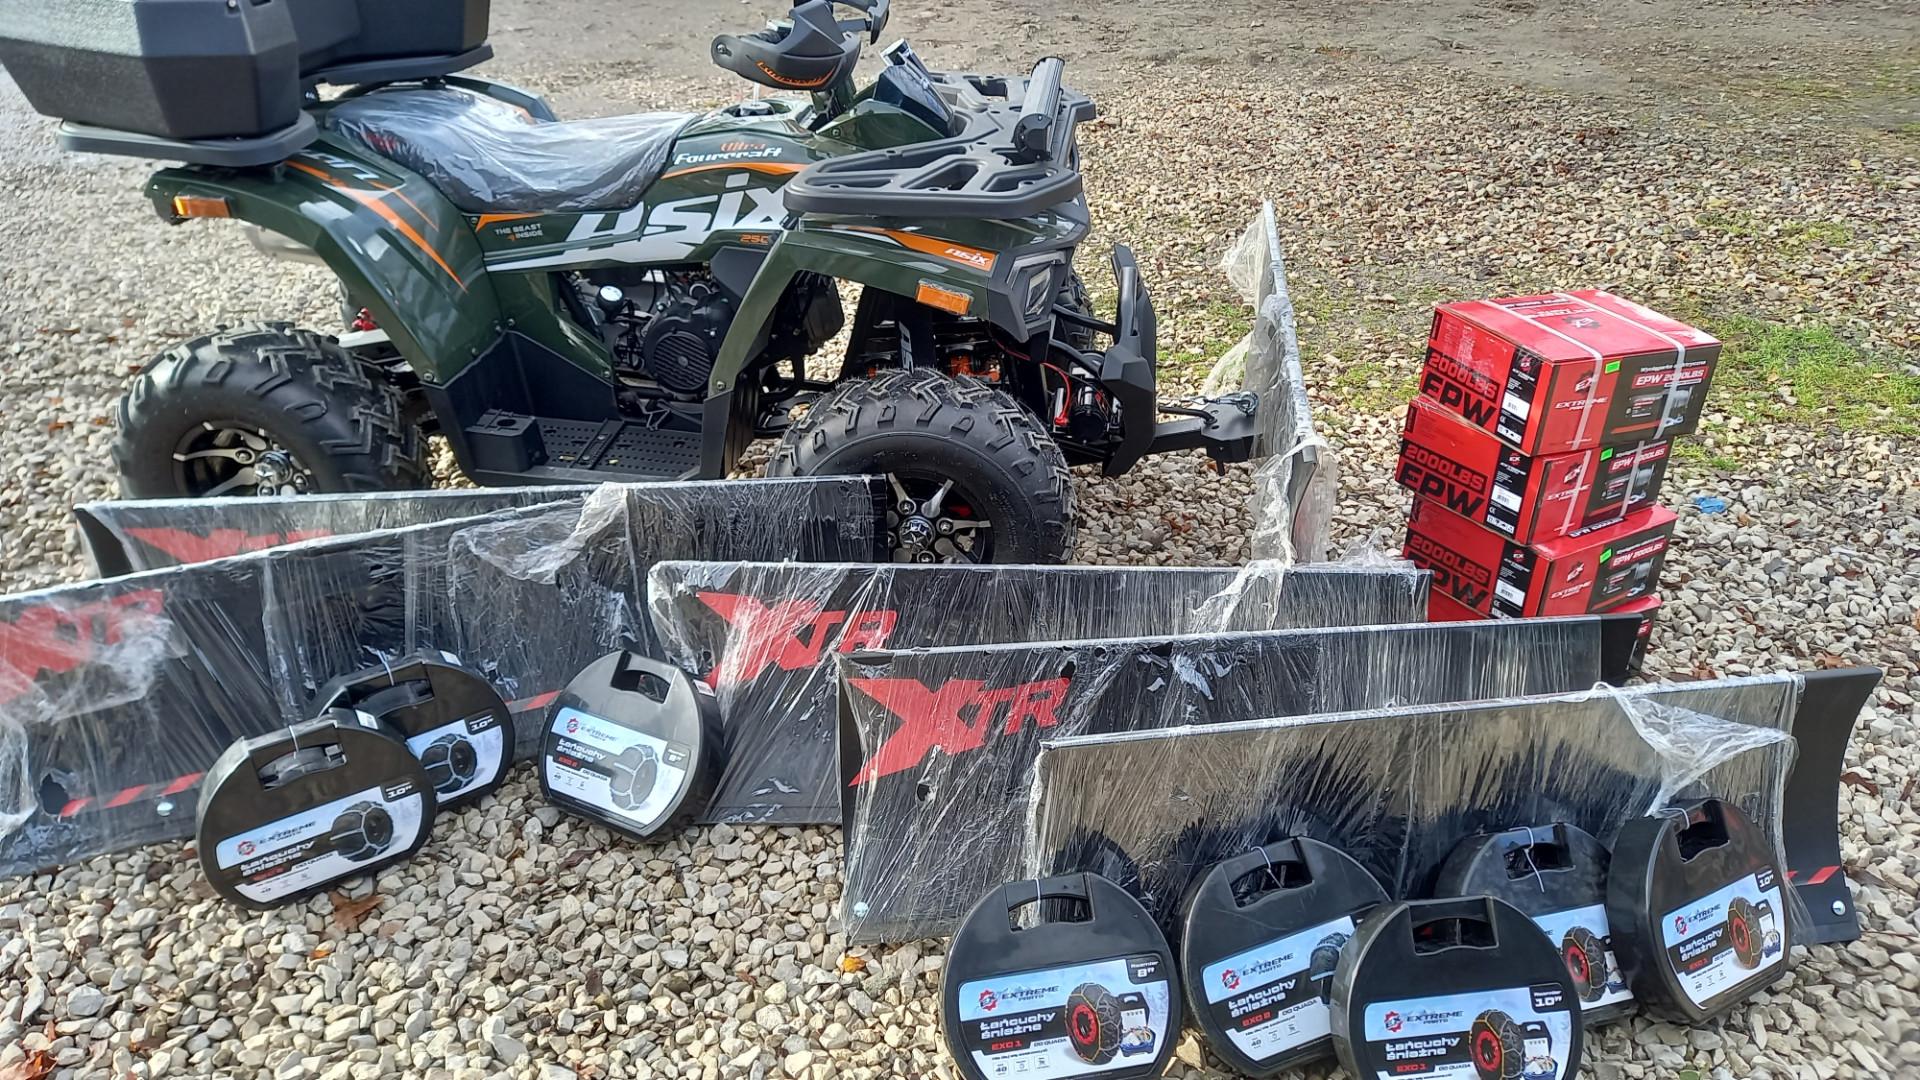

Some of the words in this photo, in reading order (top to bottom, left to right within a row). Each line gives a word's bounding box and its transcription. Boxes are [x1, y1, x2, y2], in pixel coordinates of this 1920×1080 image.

[674, 146, 783, 165] Fourcraft
[512, 223, 542, 233] BEAST
[1428, 354, 1498, 398] 2000LBS
[1635, 374, 1663, 386] EPW
[1422, 372, 1497, 428] EPW
[1405, 445, 1484, 490] 2000LBS
[1400, 462, 1483, 518] EPW
[1410, 535, 1490, 586] 2000LBS
[697, 591, 898, 687] XTR
[848, 677, 1071, 786] XTR
[1759, 874, 1774, 888] 10"
[1137, 967, 1155, 978] 8"
[1243, 953, 1294, 976] EXTREME
[1002, 986, 1060, 1000] EXTREME
[1534, 996, 1562, 1007] 10"
[1293, 999, 1317, 1012] QUADA
[1406, 1011, 1464, 1022] EXTREME
